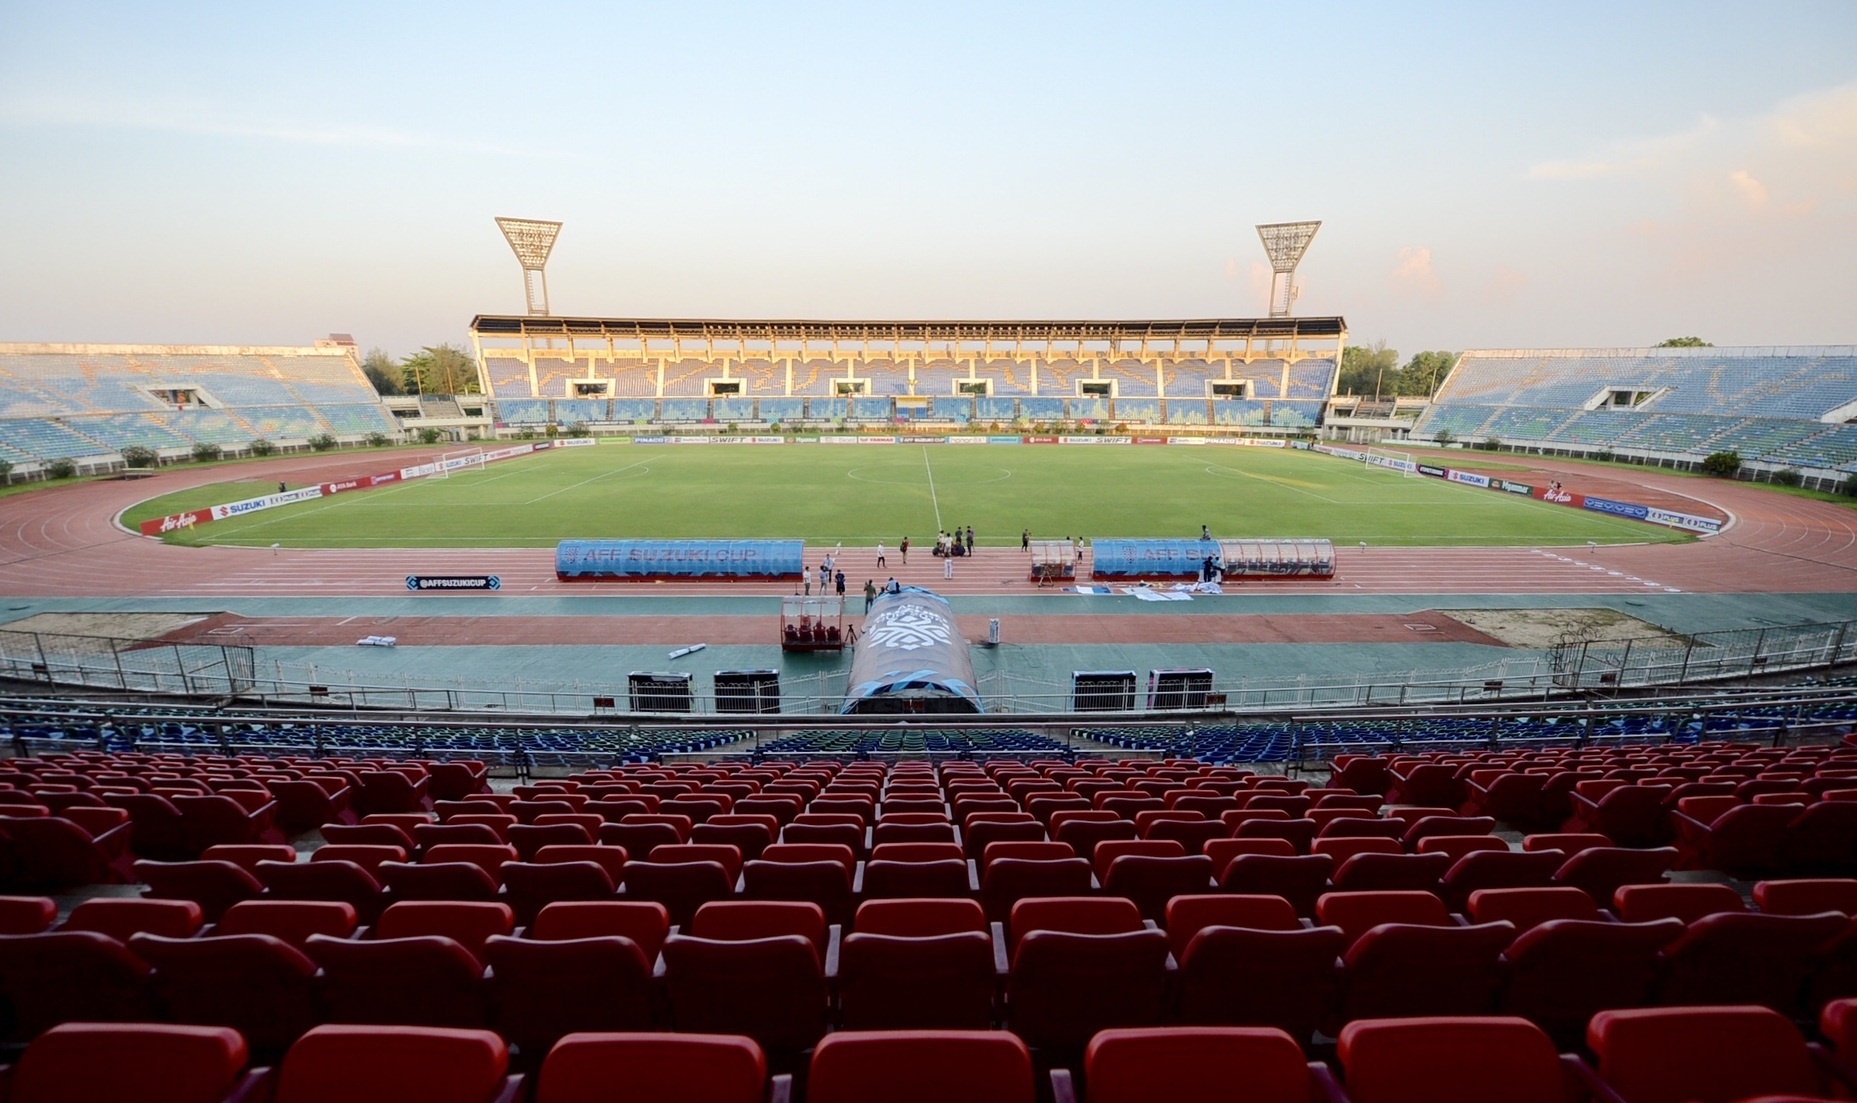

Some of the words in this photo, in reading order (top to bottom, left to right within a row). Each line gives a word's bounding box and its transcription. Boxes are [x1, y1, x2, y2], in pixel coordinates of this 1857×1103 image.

[1459, 474, 1485, 485] SUZUKI
[1501, 481, 1529, 493] Myanmar
[230, 500, 266, 514] SUZUKI
[1699, 521, 1717, 530] PLUS
[583, 549, 622, 561] AFF
[629, 549, 709, 561] SUZUKI
[716, 549, 758, 561] CUP
[1143, 549, 1178, 561] AFF
[420, 579, 487, 588] @AFFSUZUKICUP
